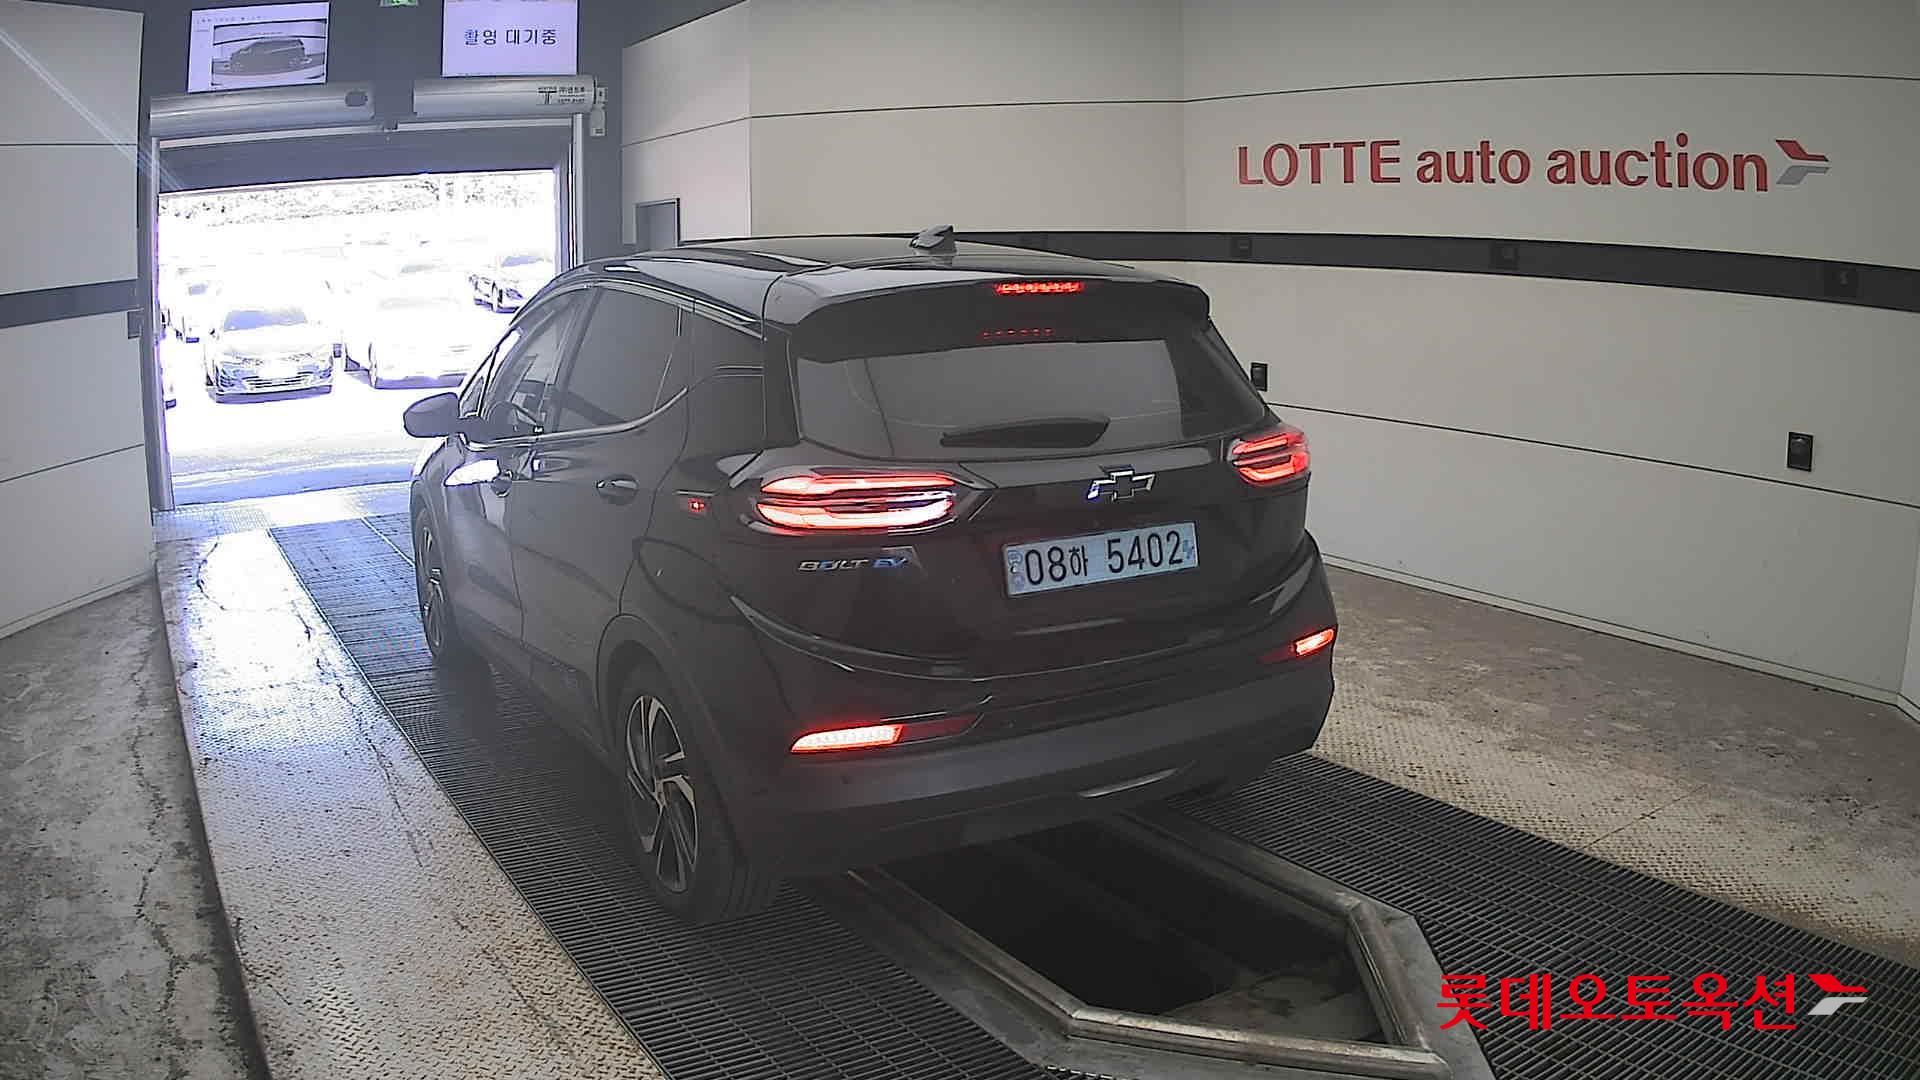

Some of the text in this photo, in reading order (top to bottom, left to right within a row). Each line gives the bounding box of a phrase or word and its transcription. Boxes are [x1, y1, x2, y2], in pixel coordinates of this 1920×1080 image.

[465, 28, 556, 46] 촬영 대기중
[1238, 132, 1769, 192] LOTTE auto auction
[798, 558, 907, 571] BOLT EV
[1025, 546, 1088, 585] 08하
[1107, 530, 1183, 573] 5402
